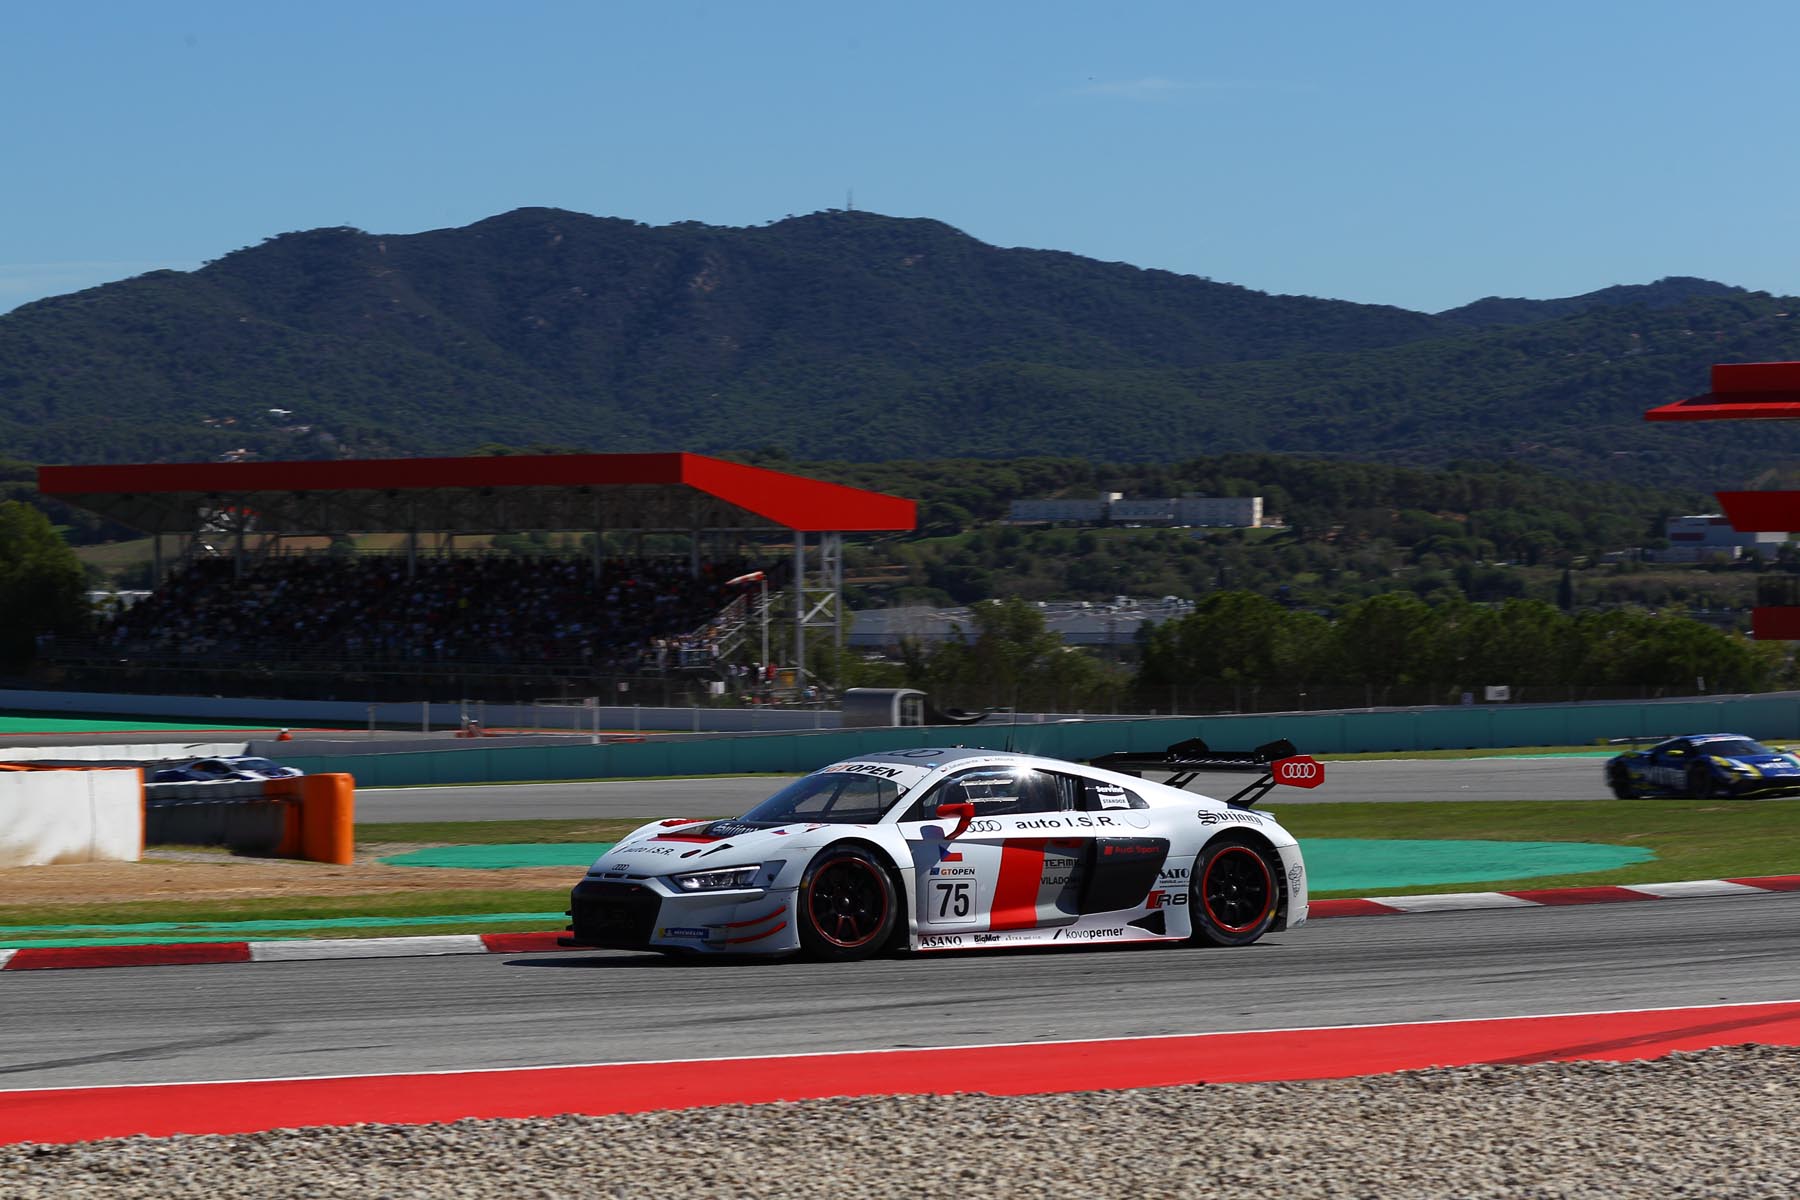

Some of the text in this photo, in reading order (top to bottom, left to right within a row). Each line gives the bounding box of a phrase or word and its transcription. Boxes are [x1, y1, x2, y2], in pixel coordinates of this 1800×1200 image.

[1015, 816, 1121, 830] auto I.S.R.
[1159, 868, 1190, 880] SATO
[936, 883, 970, 917] 75
[1156, 893, 1187, 907] R8
[1065, 927, 1124, 940] kovoperner
[921, 935, 962, 947] ASANO
